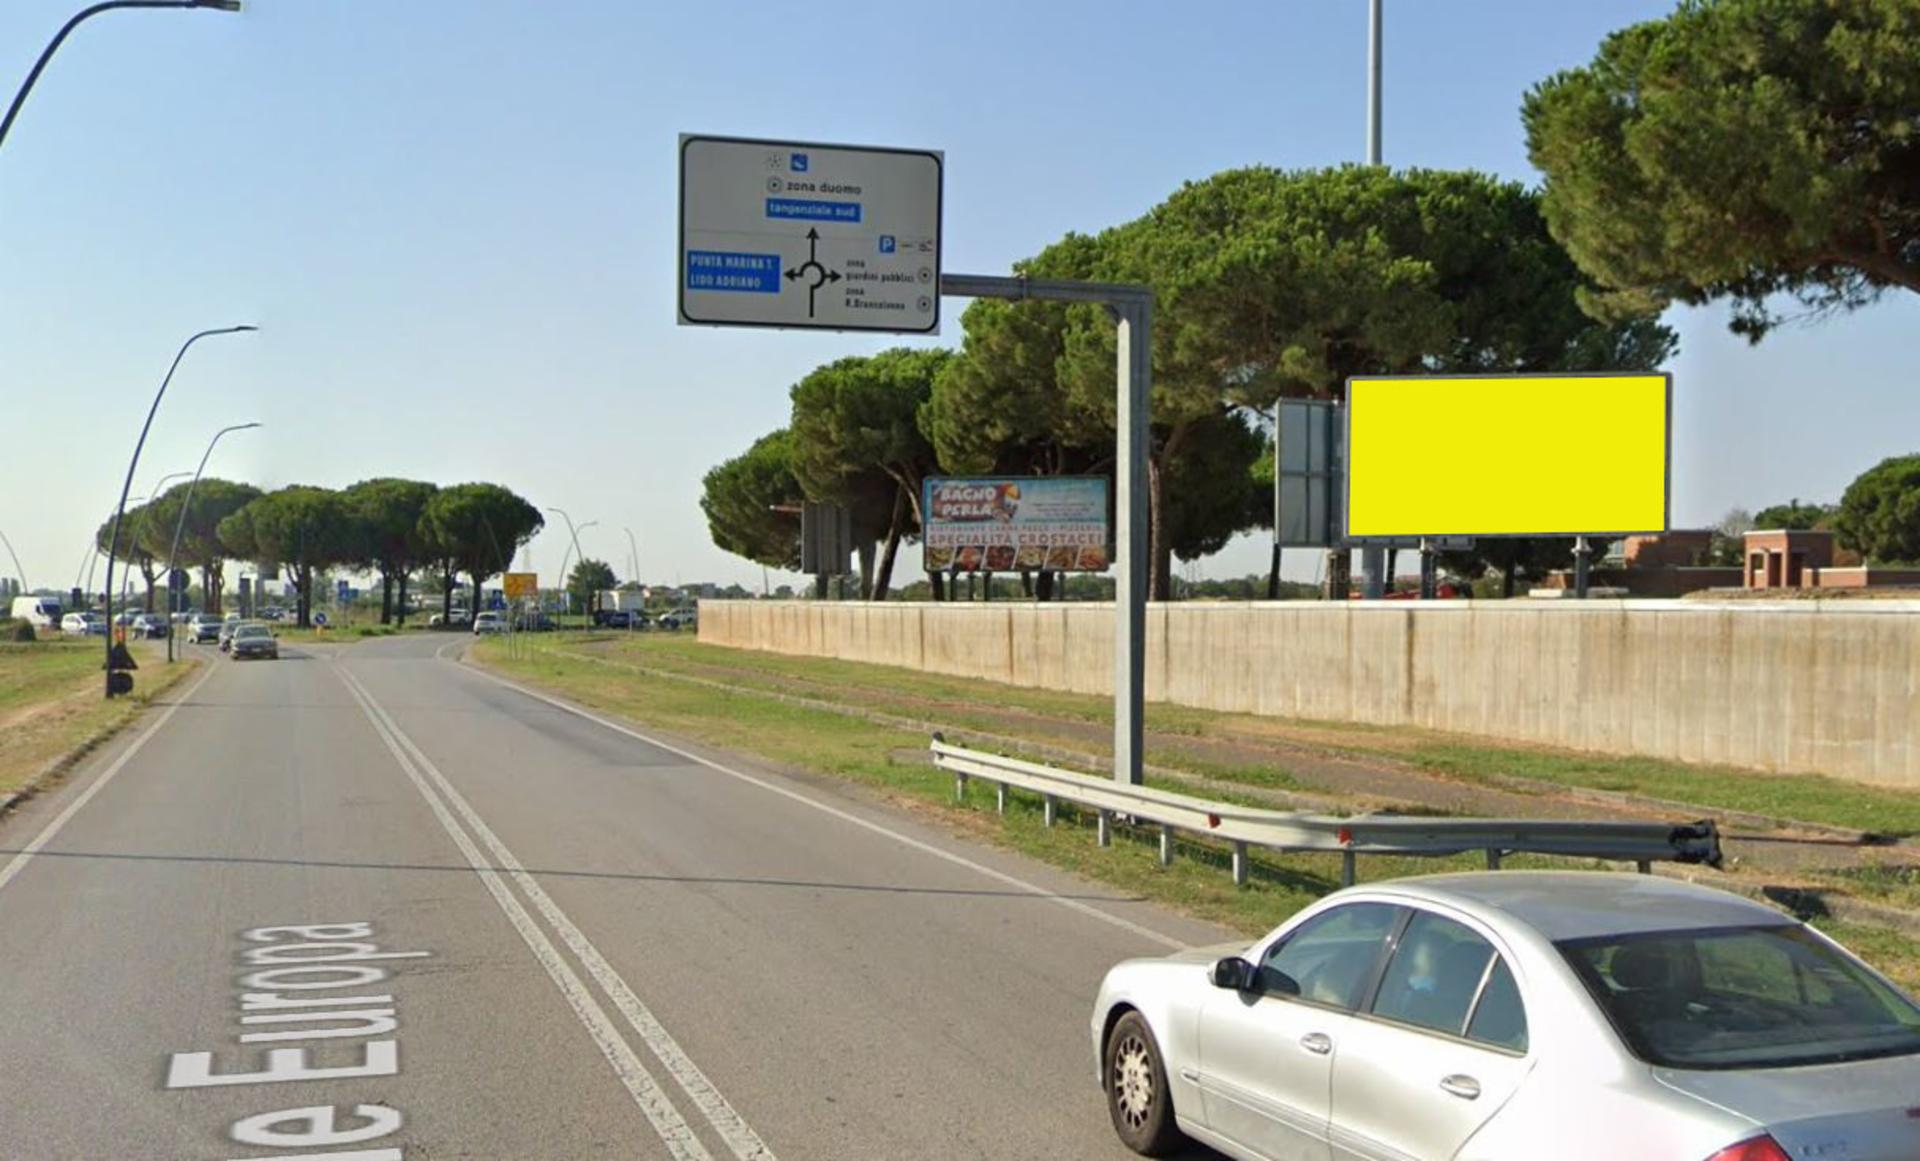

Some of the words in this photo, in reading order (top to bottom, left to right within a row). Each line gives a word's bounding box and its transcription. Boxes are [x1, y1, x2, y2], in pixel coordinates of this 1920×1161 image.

[787, 181, 816, 192] zona
[820, 182, 862, 195] duomo
[770, 203, 832, 216] tangenziale
[836, 206, 856, 217] sud
[691, 254, 722, 267] PUNTA
[726, 256, 764, 269] MARINA
[691, 272, 714, 286] LIDO
[716, 275, 762, 289] ADRIANO
[1018, 533, 1102, 545] CROSTACEI
